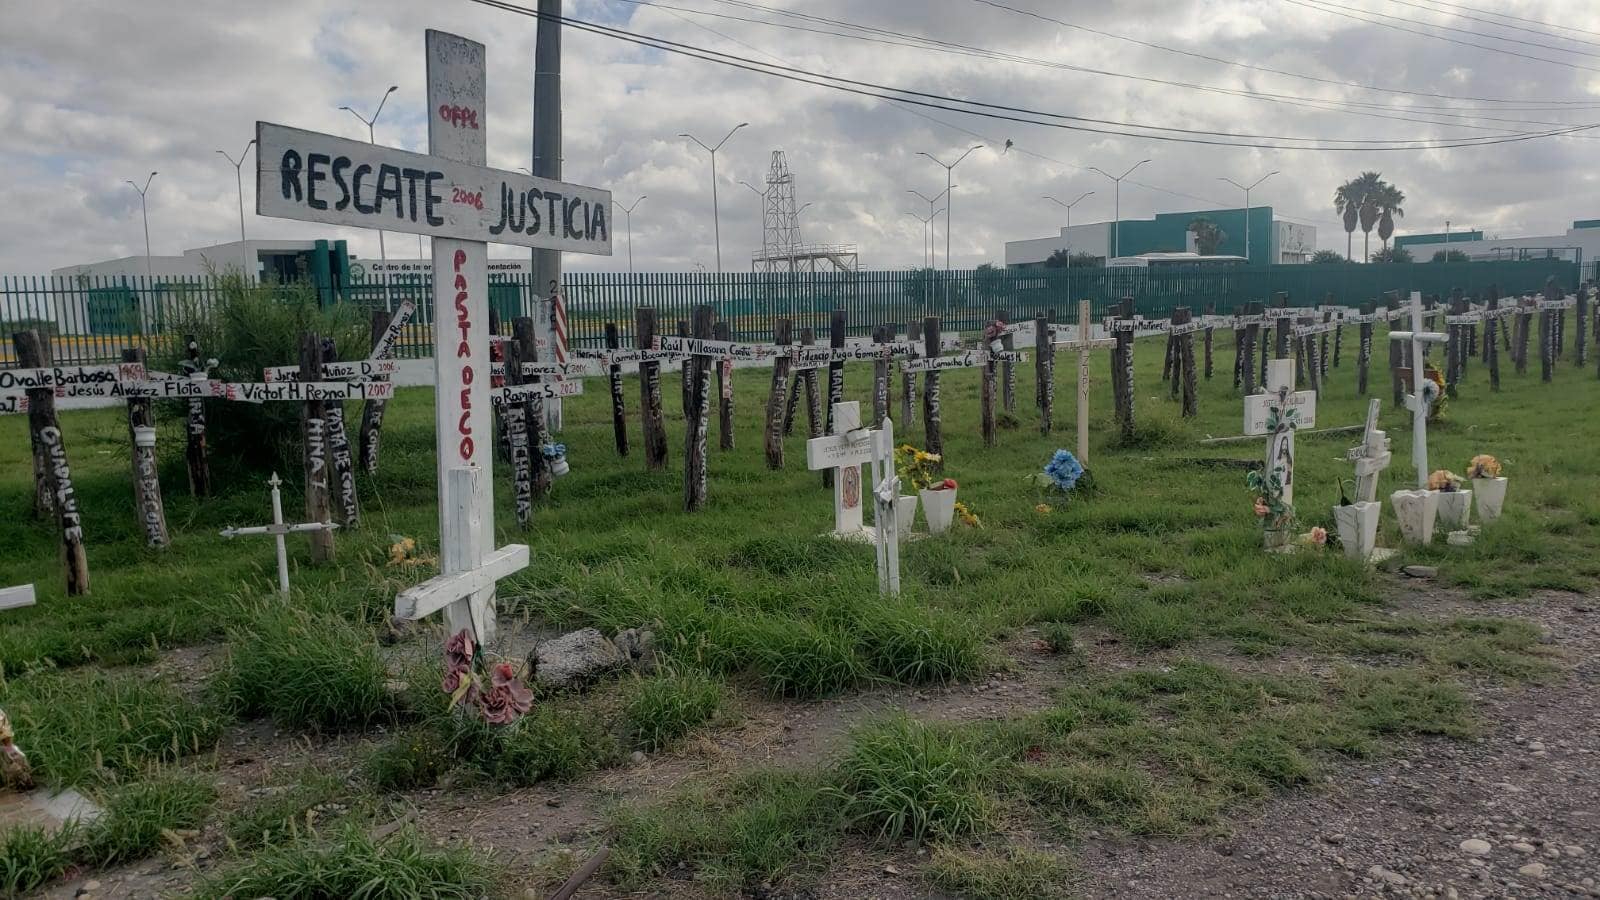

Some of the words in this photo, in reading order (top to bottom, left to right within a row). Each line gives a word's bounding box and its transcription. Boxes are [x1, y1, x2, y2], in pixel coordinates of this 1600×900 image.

[281, 149, 445, 228] RESCATE
[452, 187, 484, 211] 2006
[489, 181, 607, 242] JUSTICIA
[372, 263, 399, 271] Cetro
[453, 249, 471, 358] PASTA
[660, 336, 682, 352] Raúl
[687, 339, 726, 356] Villasana
[889, 342, 909, 356] sales
[0, 370, 52, 388] Ovalle
[54, 367, 118, 387] Barbosa
[68, 384, 105, 397] Jesús
[164, 382, 202, 396] Flota
[306, 383, 346, 401] Reyna
[347, 383, 365, 400] M
[367, 383, 392, 397] 2007
[306, 418, 326, 473] MINA
[40, 425, 83, 541] GUADALUPE
